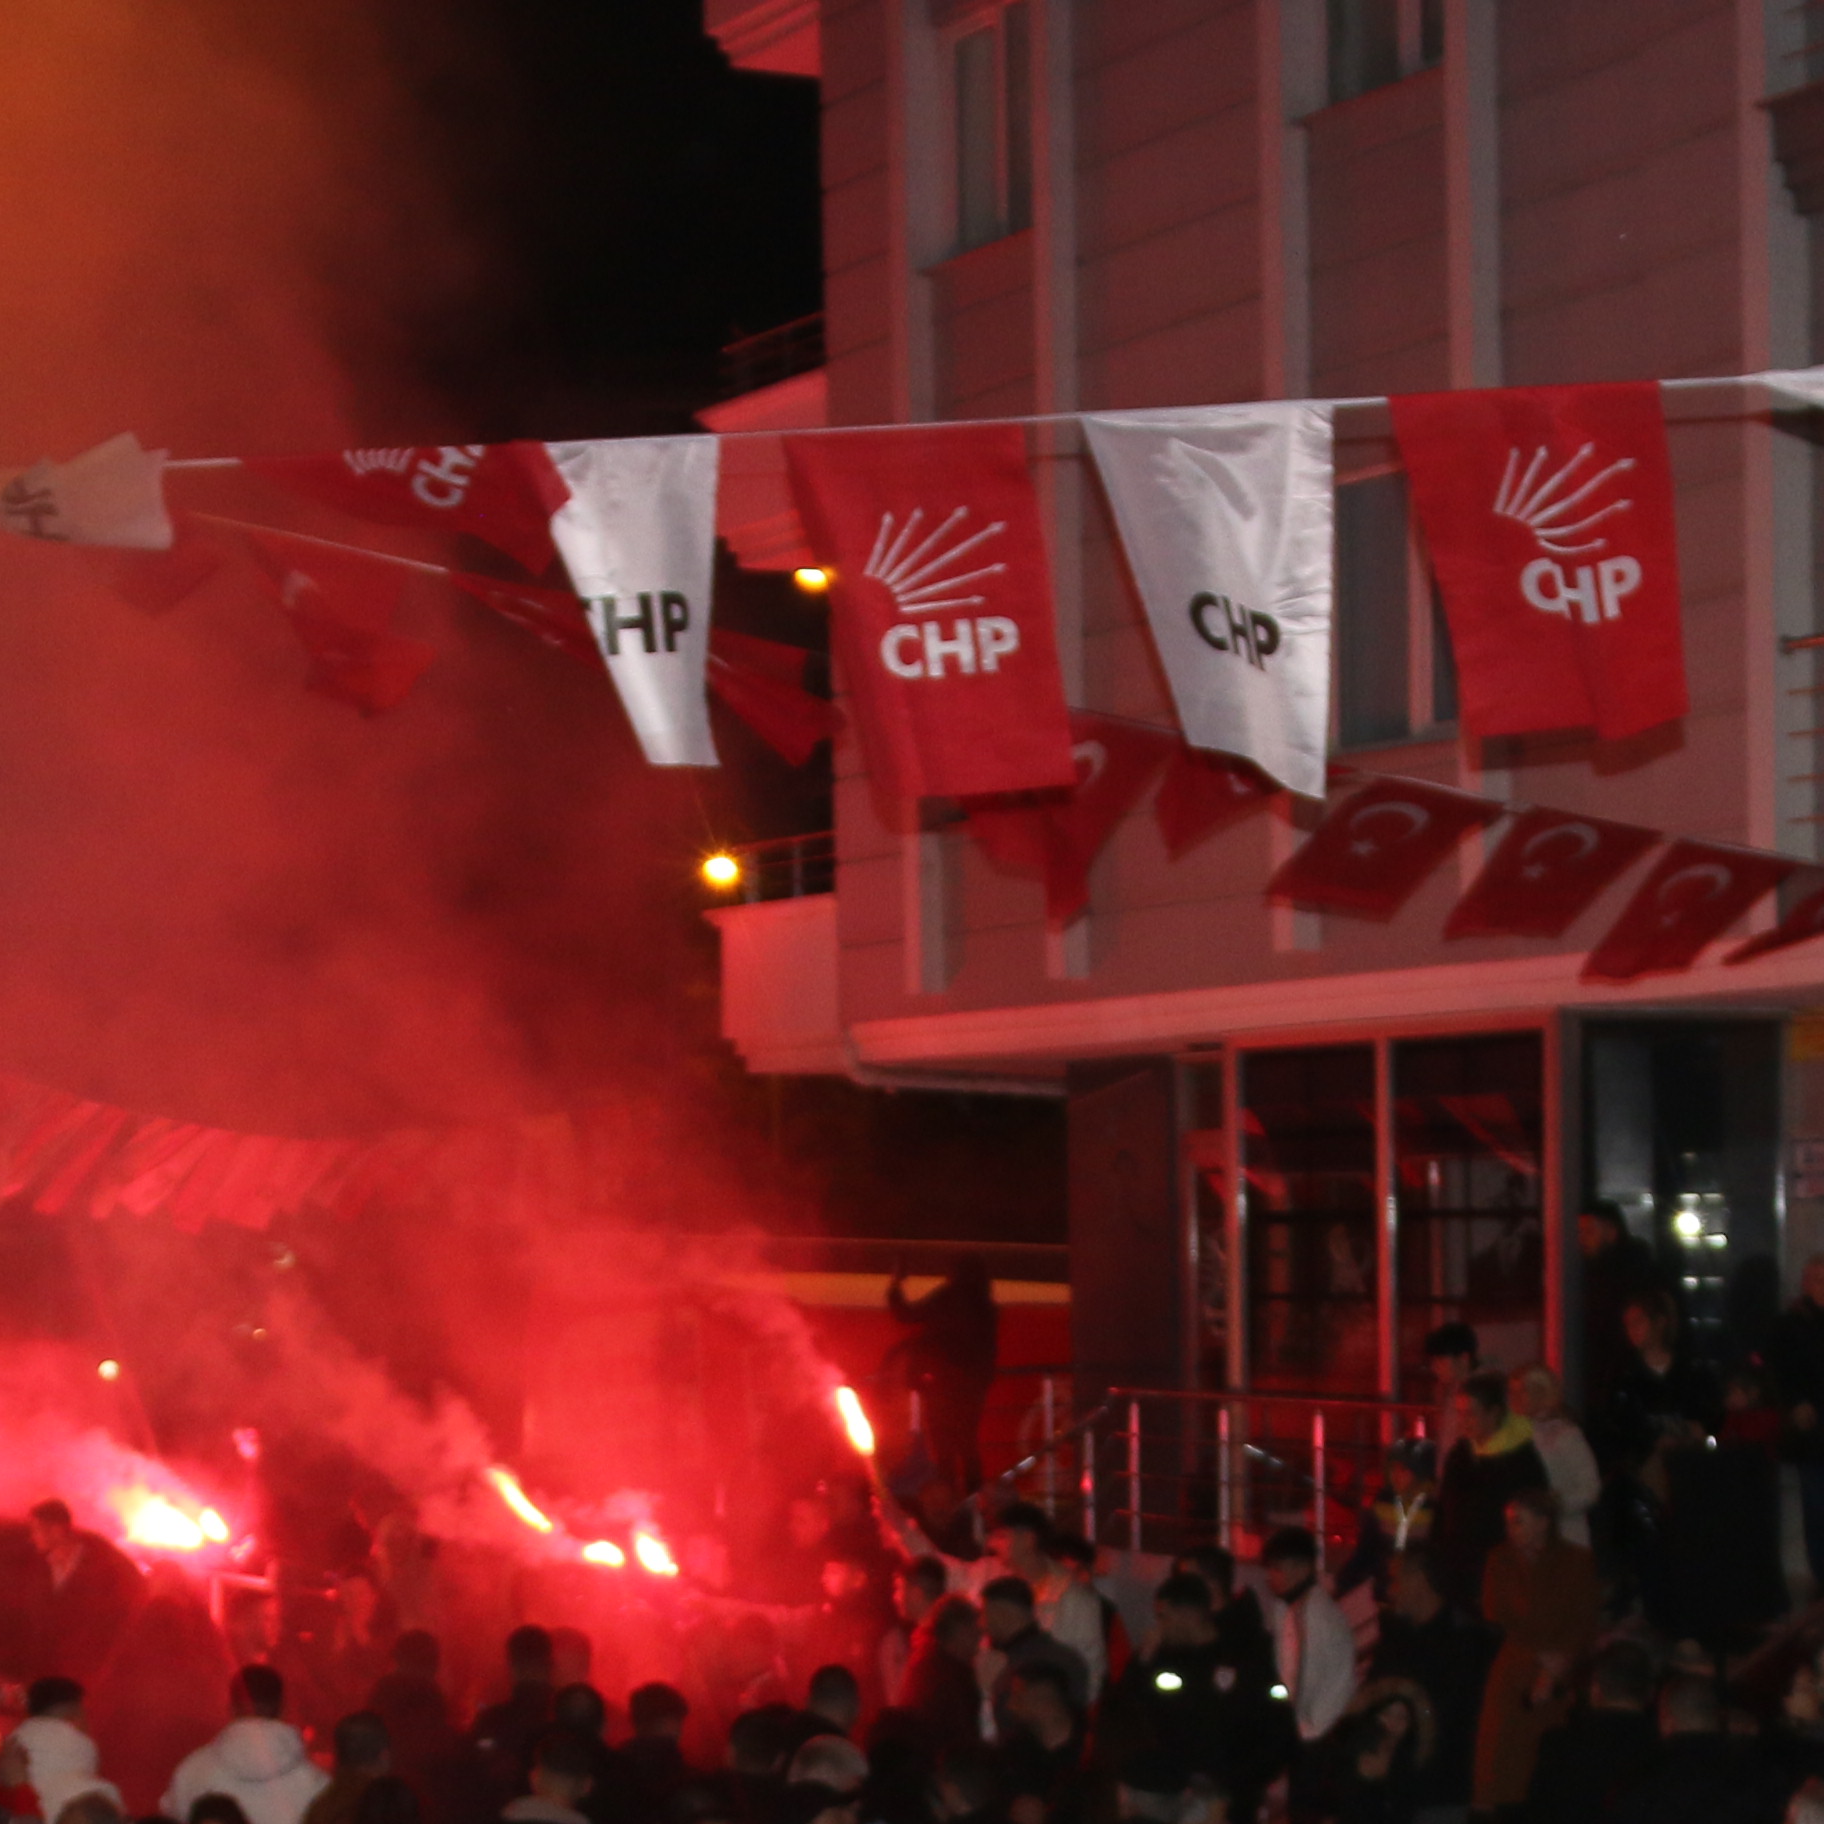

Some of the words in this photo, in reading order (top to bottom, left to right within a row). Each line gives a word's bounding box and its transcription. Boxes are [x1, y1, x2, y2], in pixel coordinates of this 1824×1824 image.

[412, 445, 486, 508] CH
[1520, 552, 1643, 623] CHP
[580, 590, 690, 656] HP
[880, 614, 1020, 681] CHP
[1187, 588, 1283, 670] CHP
